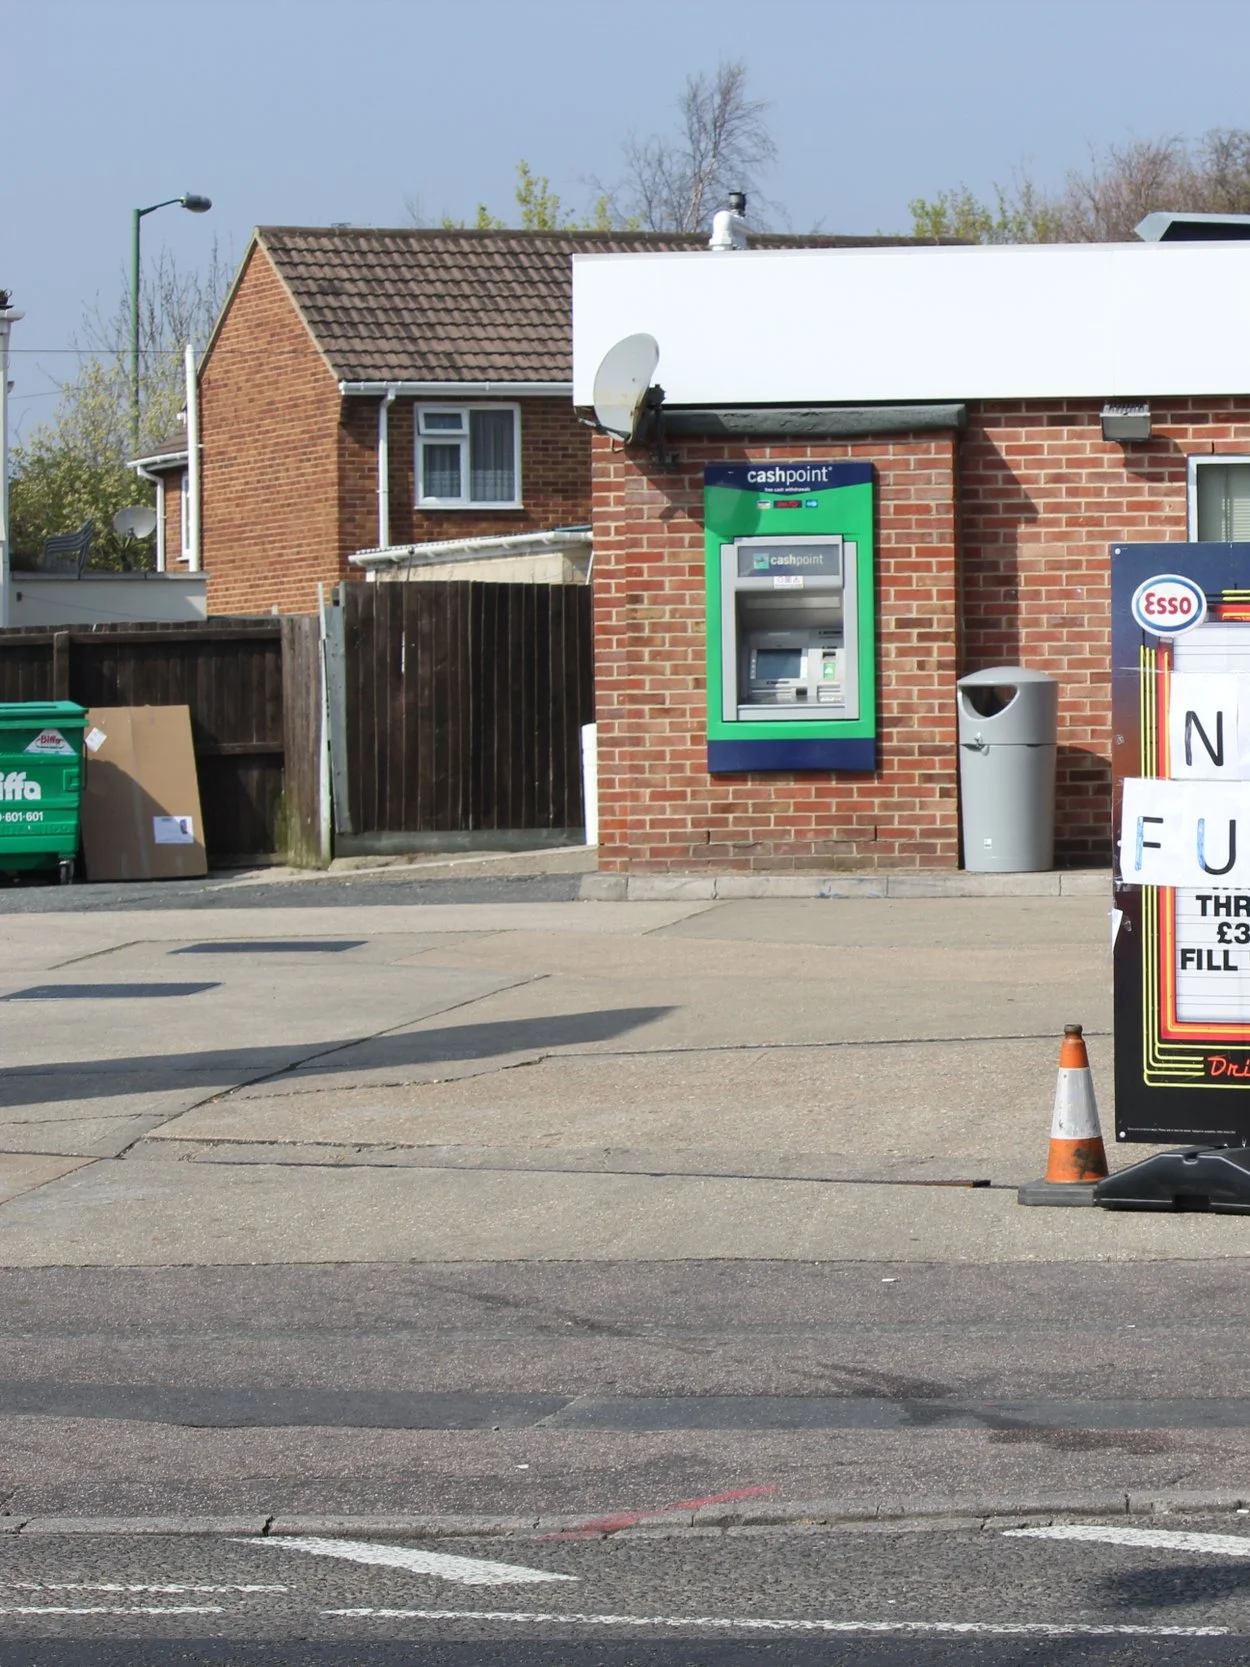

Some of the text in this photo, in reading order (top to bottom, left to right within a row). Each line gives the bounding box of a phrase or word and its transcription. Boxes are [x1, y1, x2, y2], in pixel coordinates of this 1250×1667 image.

[747, 466, 829, 485] cashpoint
[770, 554, 823, 566] cashpoint
[1144, 592, 1192, 615] Esso
[1180, 948, 1238, 971] FILL
